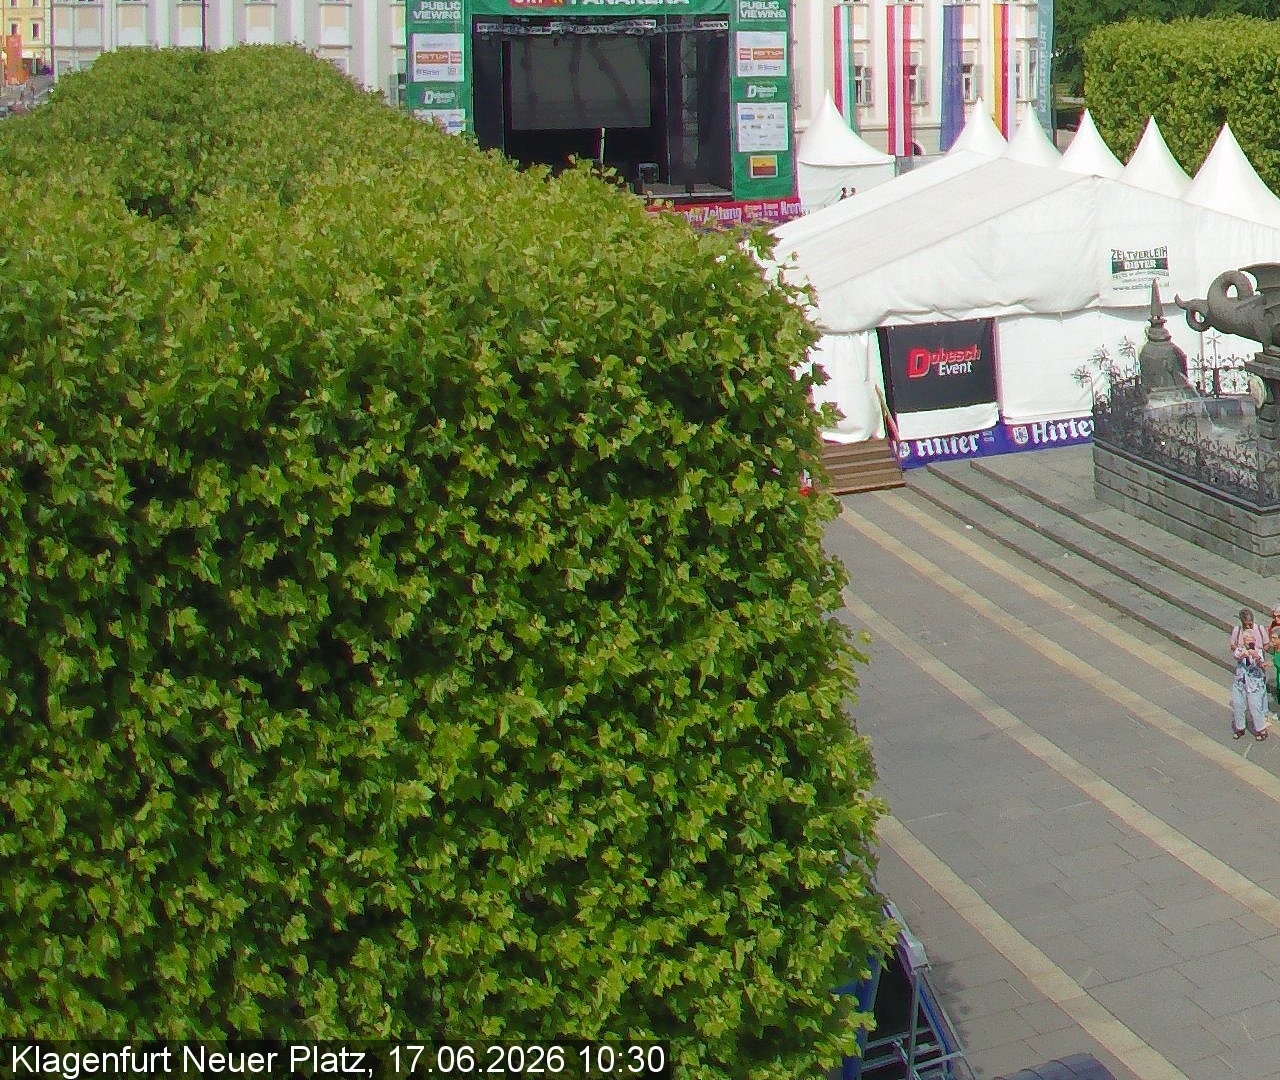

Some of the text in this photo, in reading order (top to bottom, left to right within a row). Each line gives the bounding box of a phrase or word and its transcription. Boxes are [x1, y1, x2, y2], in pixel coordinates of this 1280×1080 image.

[420, 1, 461, 11] PUBLIC
[740, 1, 779, 10] PUBLIC
[1111, 246, 1168, 261] ZELTVERLEIH
[939, 361, 972, 376] Event
